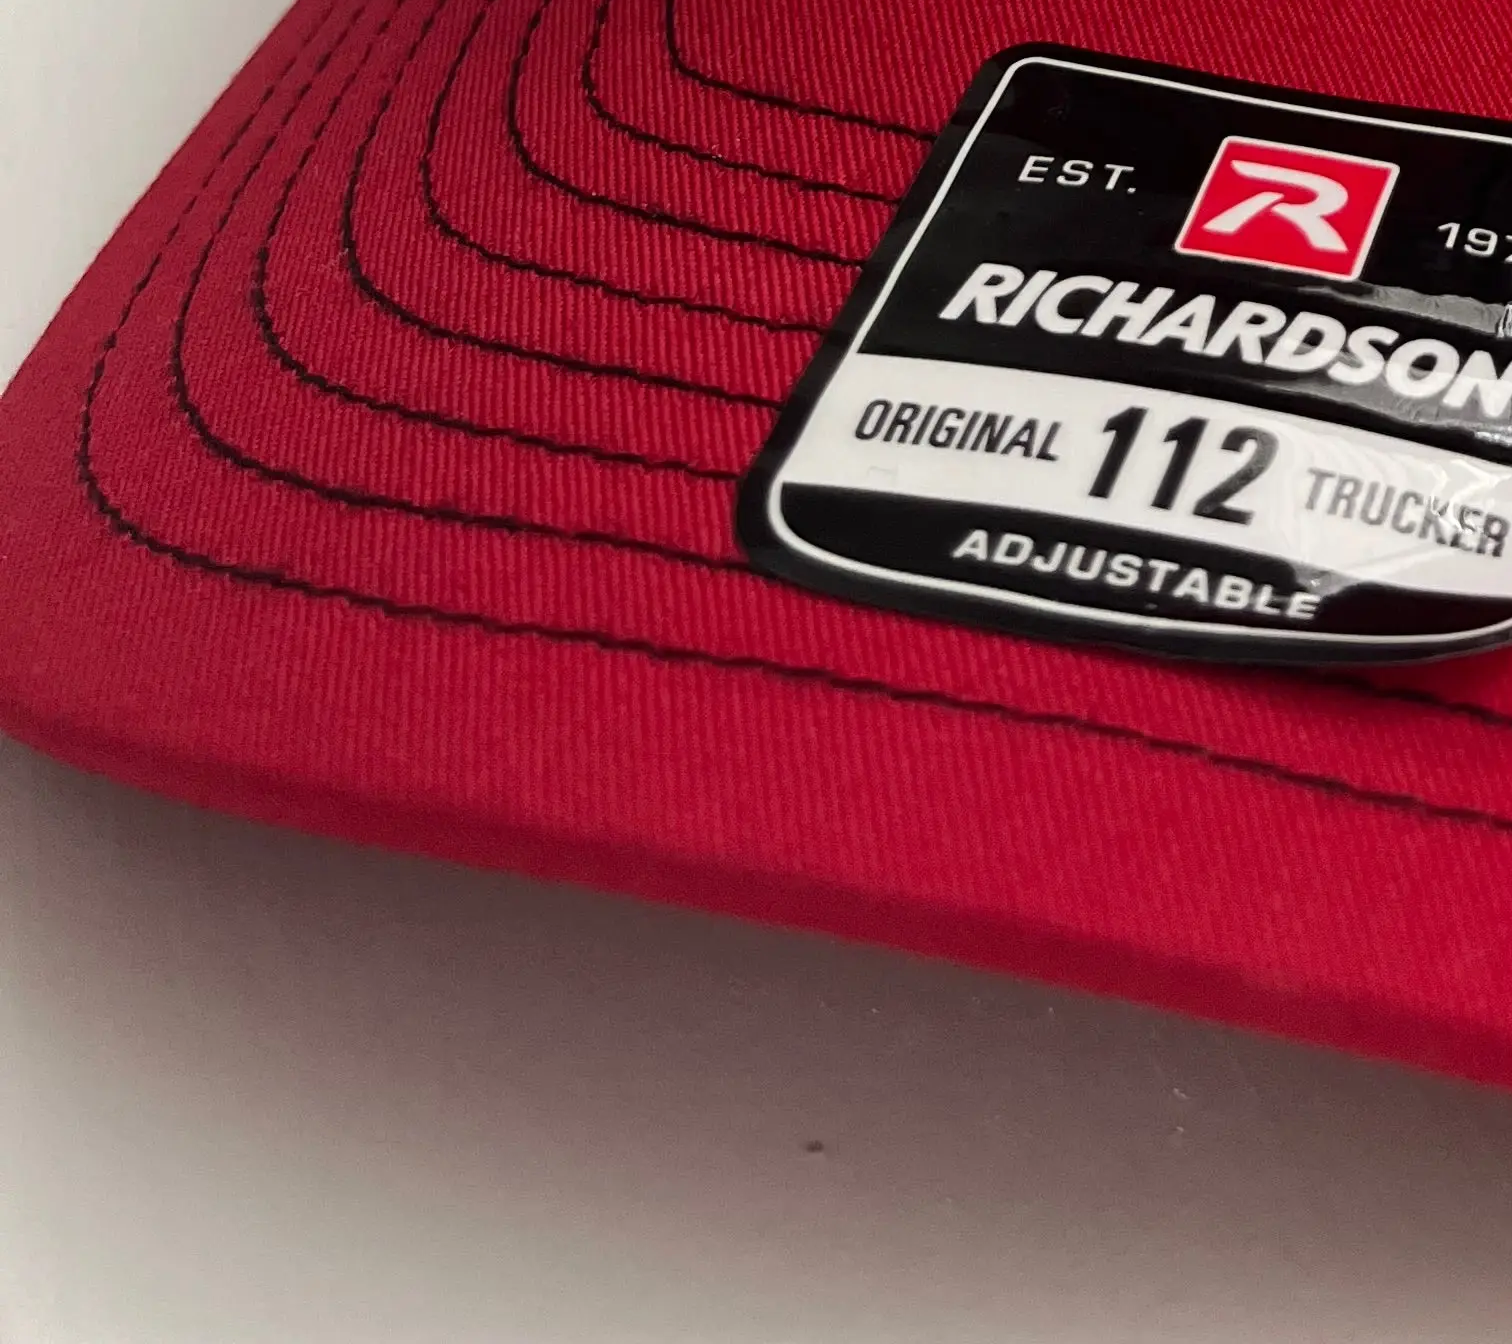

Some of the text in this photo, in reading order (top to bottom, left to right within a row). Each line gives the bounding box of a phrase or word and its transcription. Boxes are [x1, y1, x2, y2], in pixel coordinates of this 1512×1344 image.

[1018, 154, 1138, 195] EST.
[1203, 160, 1350, 251] R
[855, 399, 1511, 557] ORIGINAL 112 TRUCKER
[953, 528, 1322, 621] ADJUSTABLE
